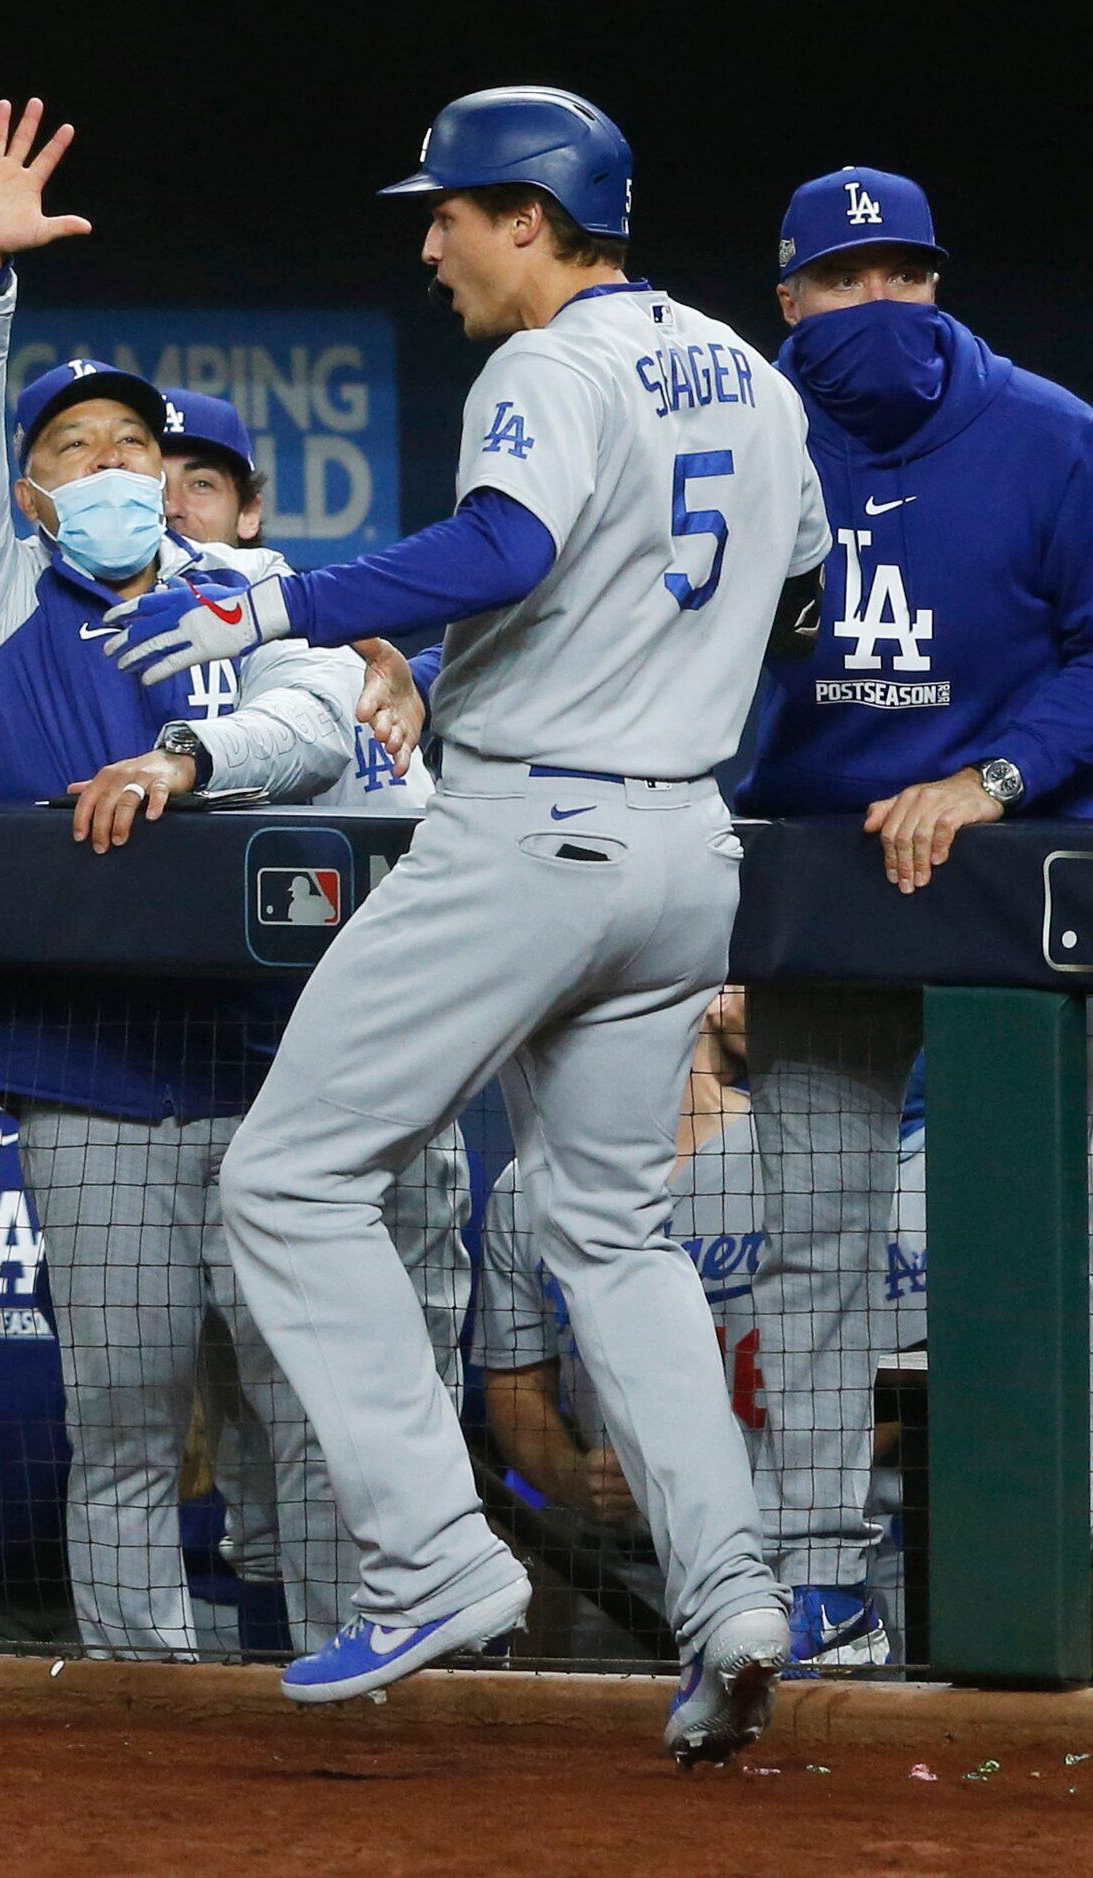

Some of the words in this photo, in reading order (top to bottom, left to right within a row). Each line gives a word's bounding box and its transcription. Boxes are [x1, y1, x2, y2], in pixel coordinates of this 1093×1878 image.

[845, 182, 883, 225] LA
[163, 395, 185, 432] A
[482, 402, 535, 460] LA
[663, 449, 735, 611] 5
[833, 528, 934, 671] LA
[815, 682, 936, 707] POSTSEASON
